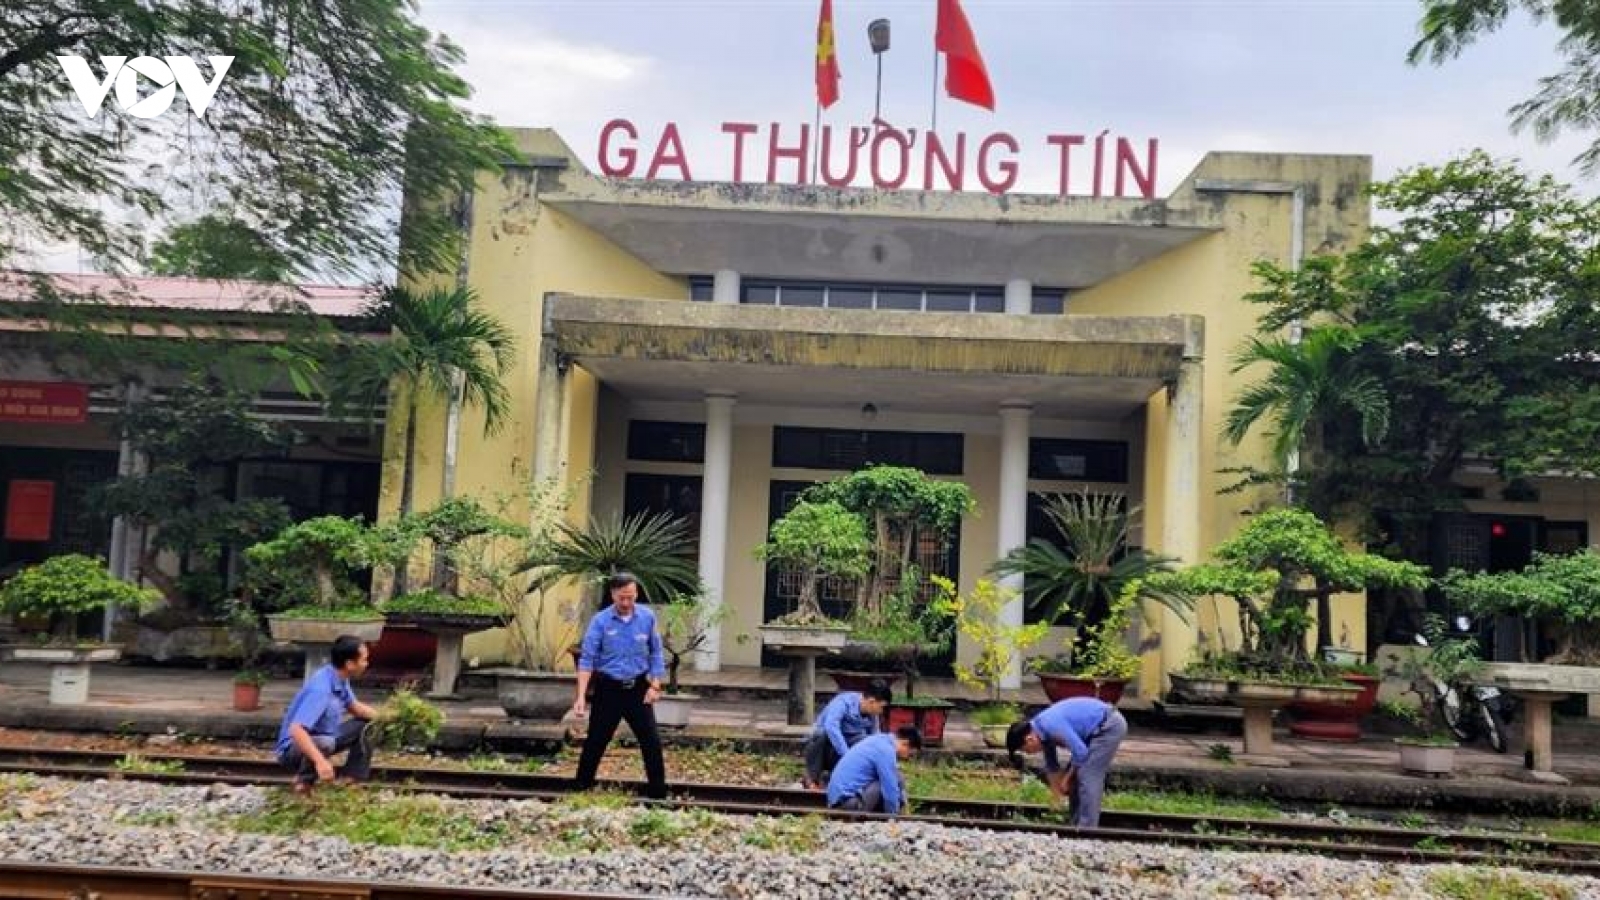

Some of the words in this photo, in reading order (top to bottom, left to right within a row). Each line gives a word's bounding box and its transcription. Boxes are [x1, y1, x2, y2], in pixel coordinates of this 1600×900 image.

[598, 119, 692, 181] GA
[721, 116, 1020, 196] THƯỜNG
[1046, 129, 1158, 198] TÍN
